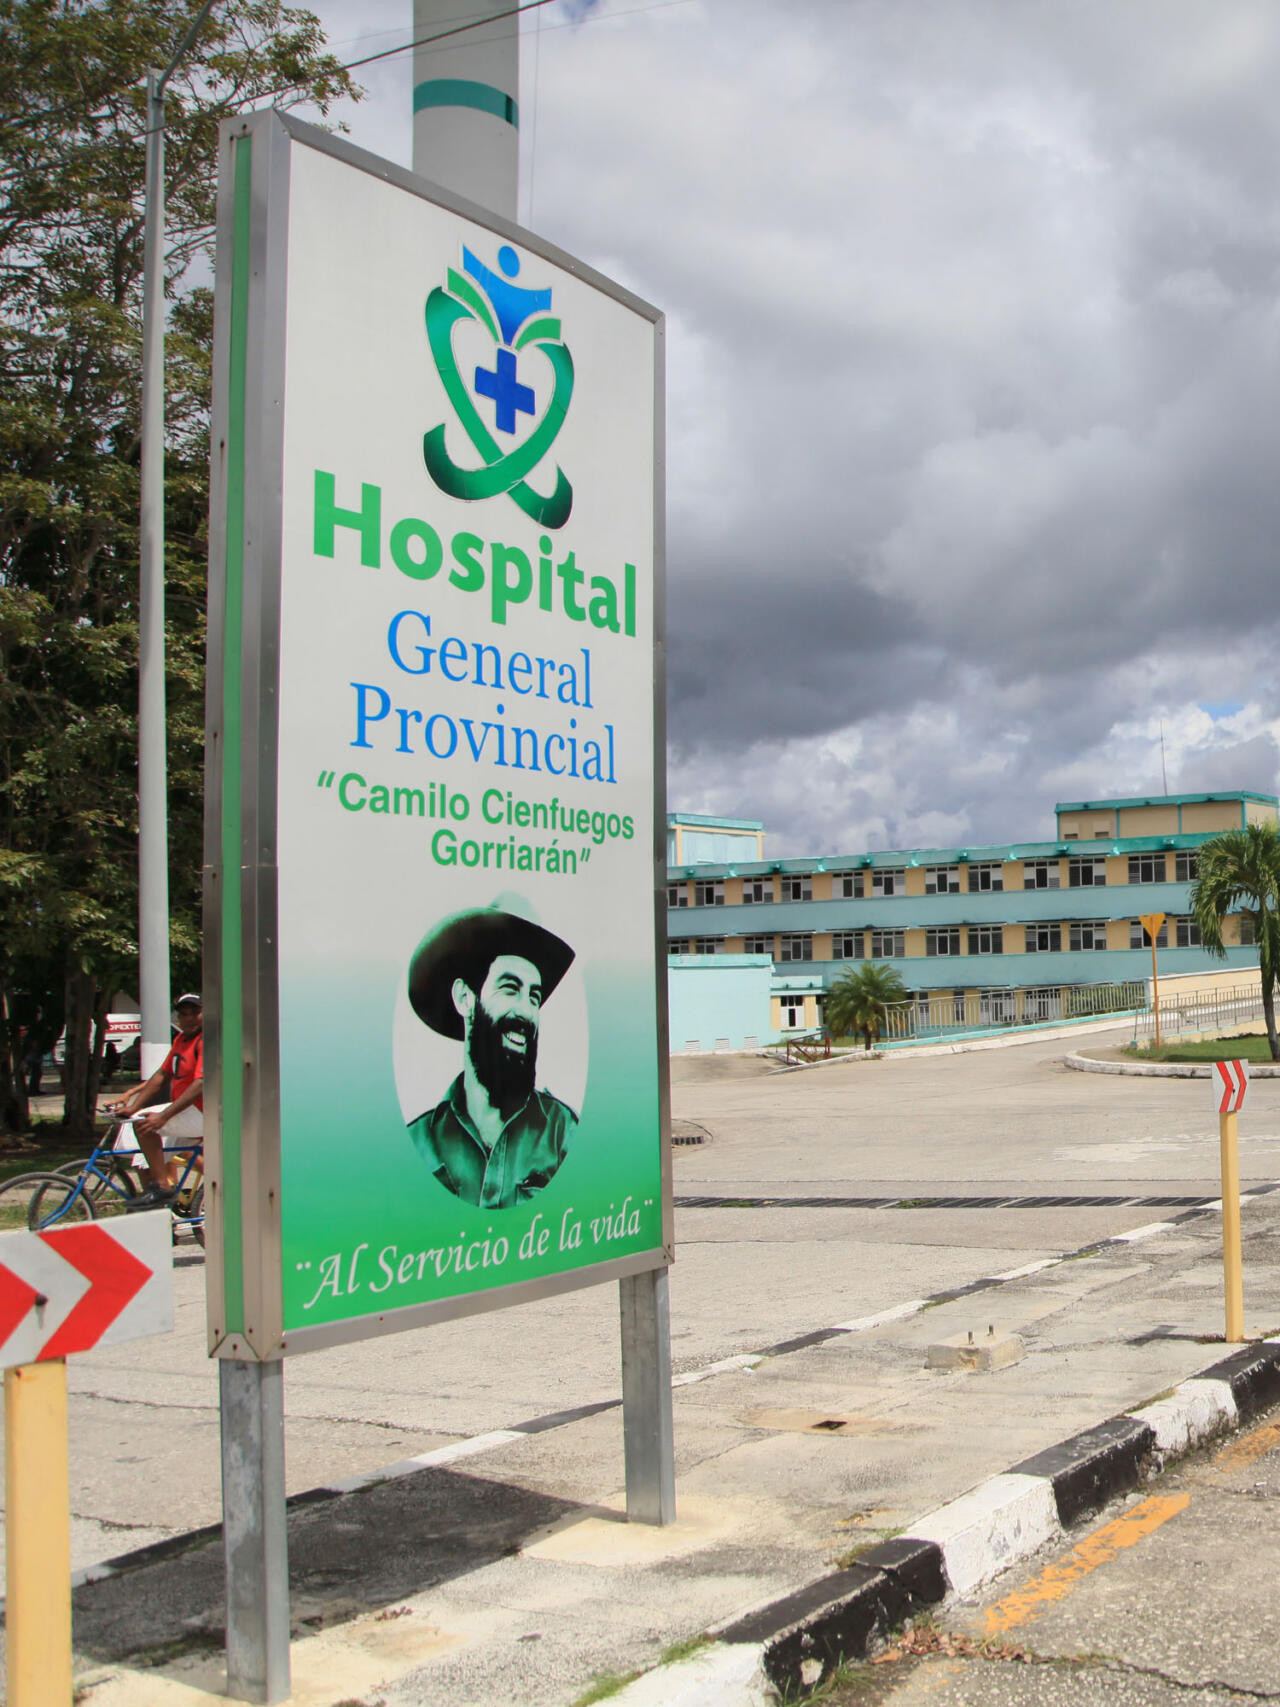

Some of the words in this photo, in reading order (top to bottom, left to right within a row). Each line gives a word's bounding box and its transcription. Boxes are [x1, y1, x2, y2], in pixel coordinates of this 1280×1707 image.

[313, 469, 637, 638] Hospital
[386, 609, 594, 709] General
[349, 681, 617, 785] Provincial
[481, 787, 635, 845] Cienfuegos
[369, 1226, 509, 1293] Servicio
[518, 1213, 550, 1260] de
[559, 1207, 583, 1251] la
